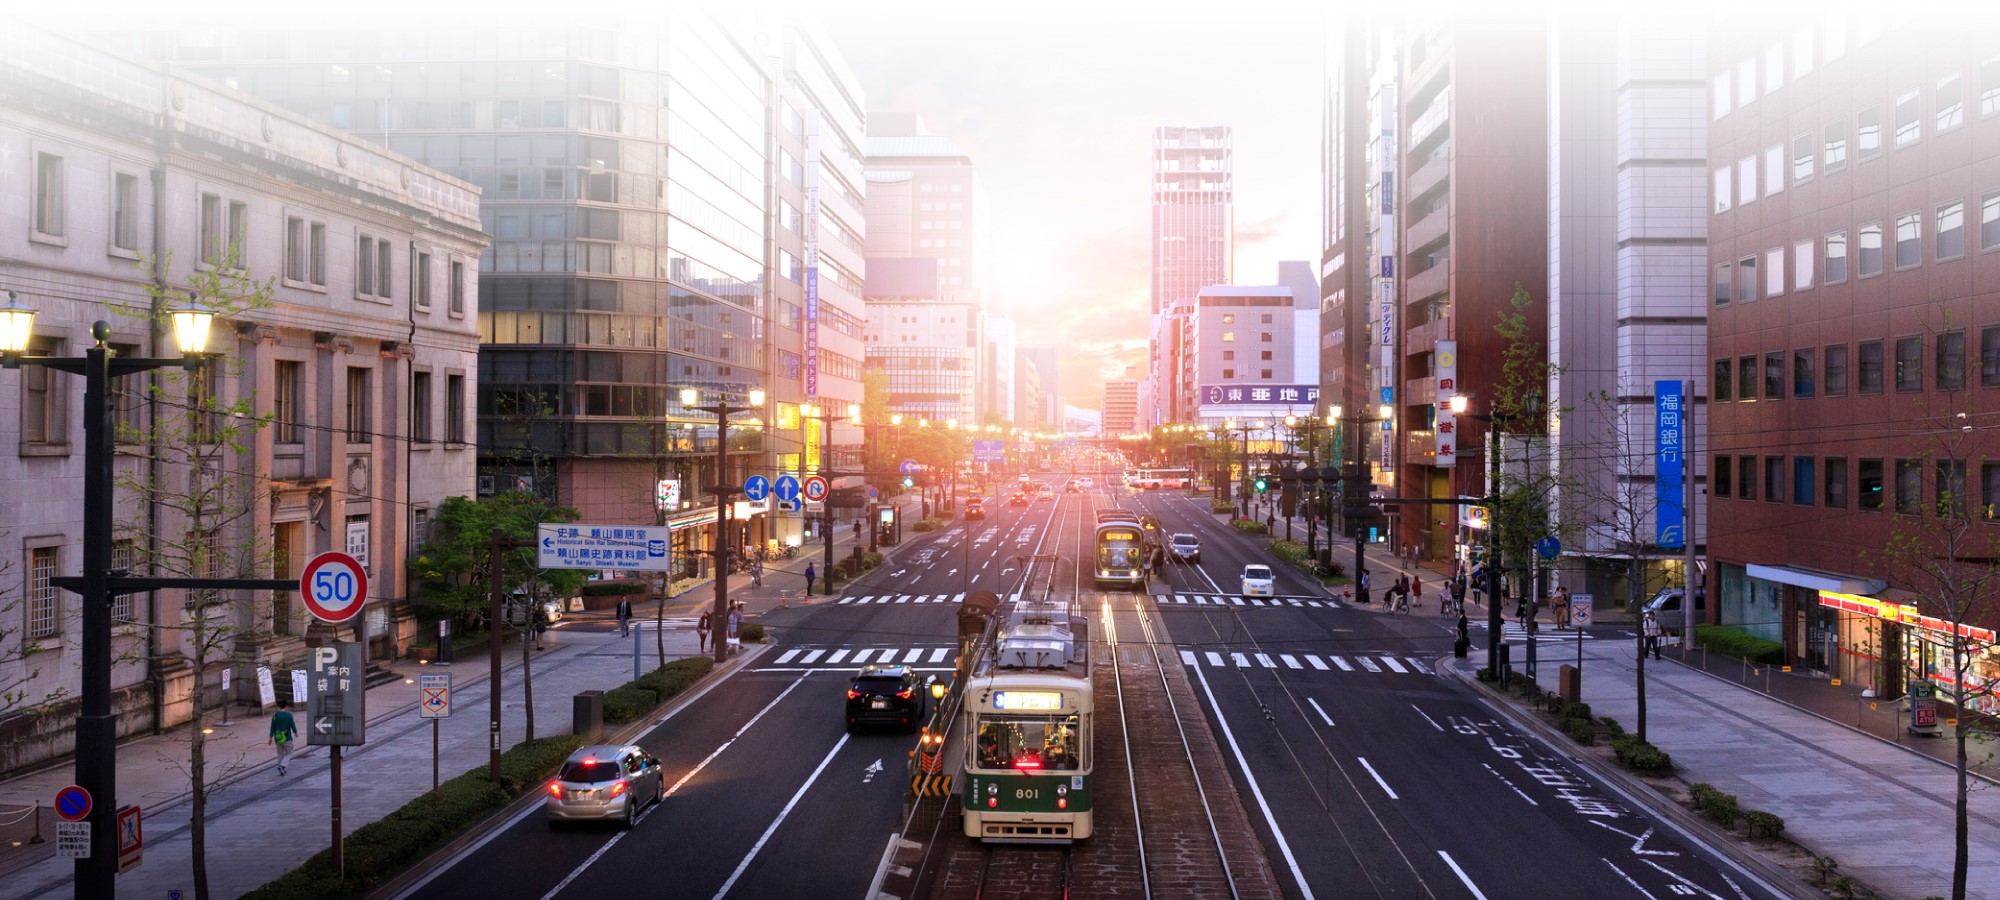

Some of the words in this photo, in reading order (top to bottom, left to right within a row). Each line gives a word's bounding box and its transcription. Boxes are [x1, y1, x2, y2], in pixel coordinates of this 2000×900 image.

[1660, 394, 1678, 463] 福岡銀行
[557, 528, 578, 538] 史跡
[316, 571, 352, 601] 50
[315, 647, 338, 672] P
[327, 666, 350, 676] 案内
[1015, 788, 1039, 799] 801
